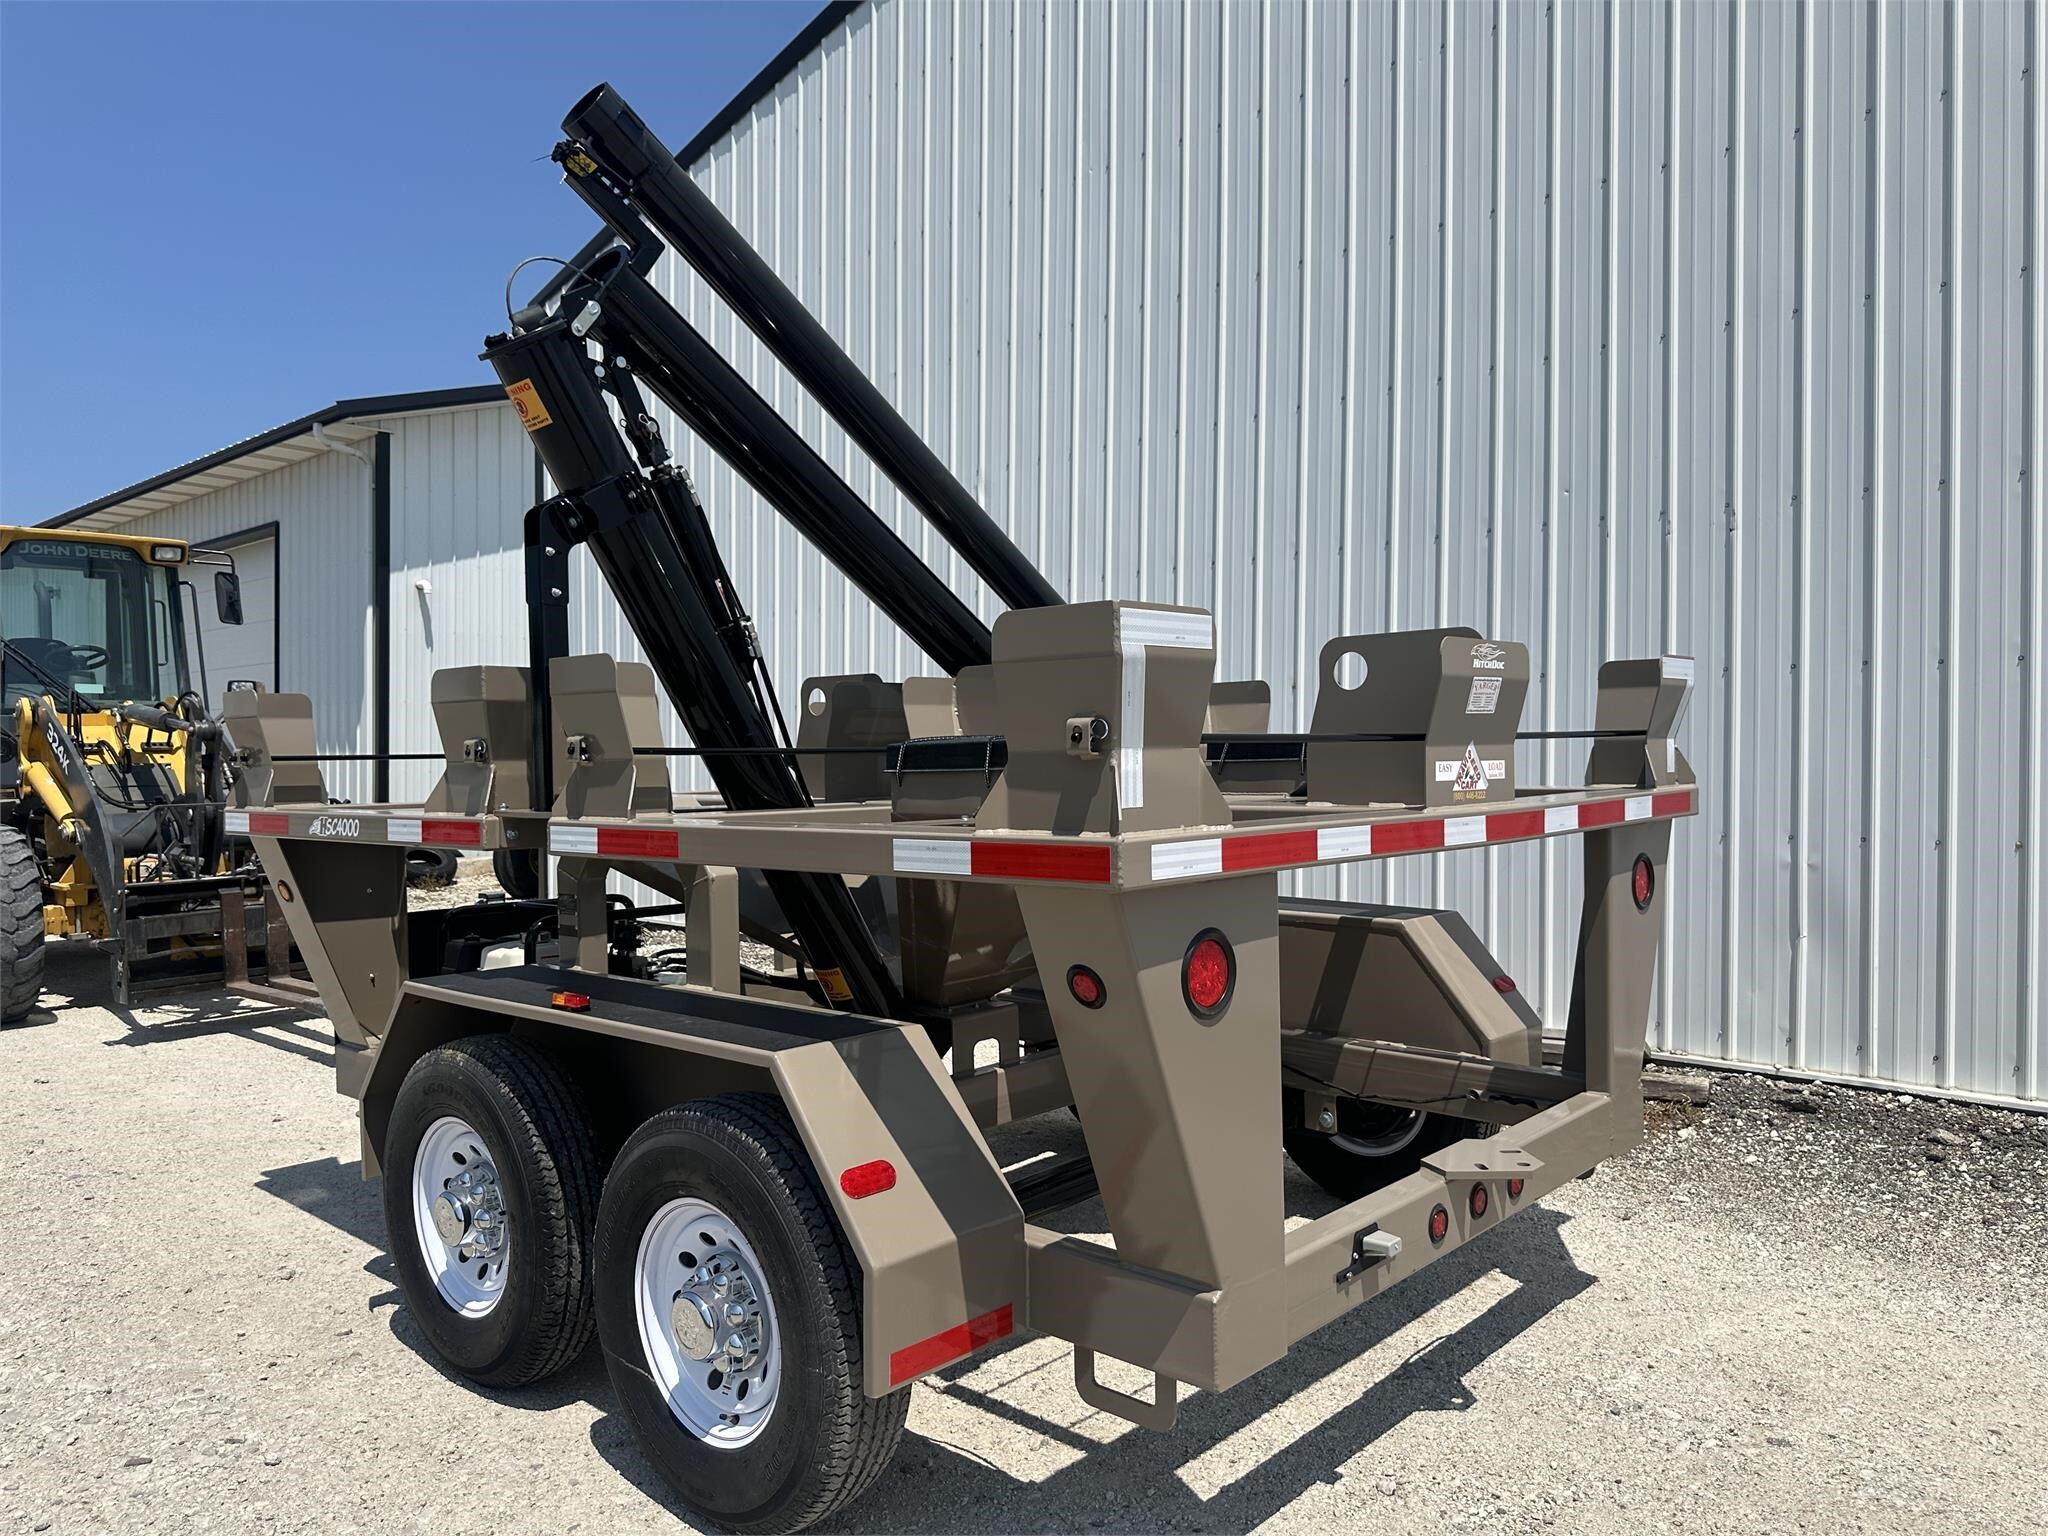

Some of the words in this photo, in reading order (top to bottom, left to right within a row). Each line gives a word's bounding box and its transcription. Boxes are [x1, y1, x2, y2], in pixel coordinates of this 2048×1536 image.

[18, 542, 71, 556] JOHN
[76, 545, 132, 561] DEERE
[47, 722, 70, 776] 324K
[1438, 763, 1453, 773] EASY
[1488, 762, 1503, 771] LOAD
[1461, 781, 1478, 790] CART
